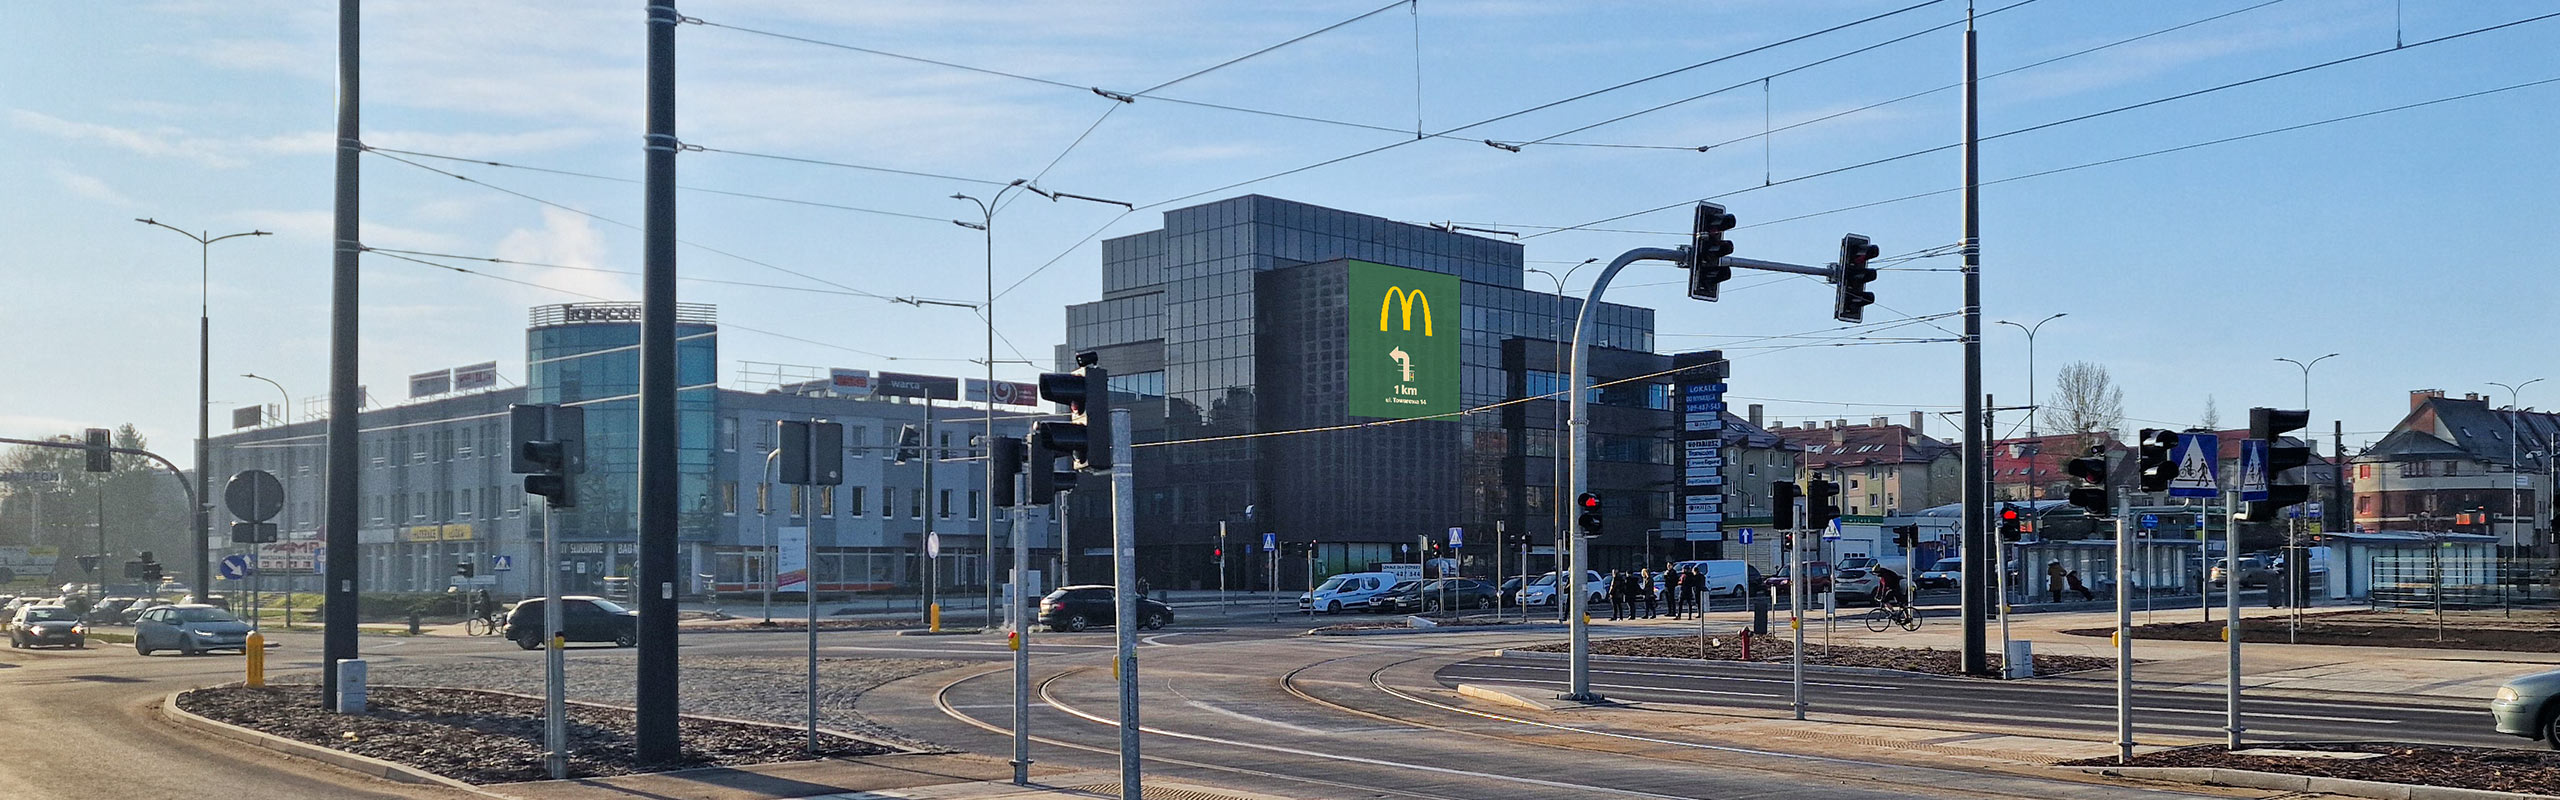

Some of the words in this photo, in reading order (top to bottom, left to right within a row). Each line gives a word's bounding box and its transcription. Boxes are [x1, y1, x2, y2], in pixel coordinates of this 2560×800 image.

[1394, 384, 1400, 395] 1
[1401, 384, 1418, 396] km
[1689, 385, 1717, 393] LOKALE
